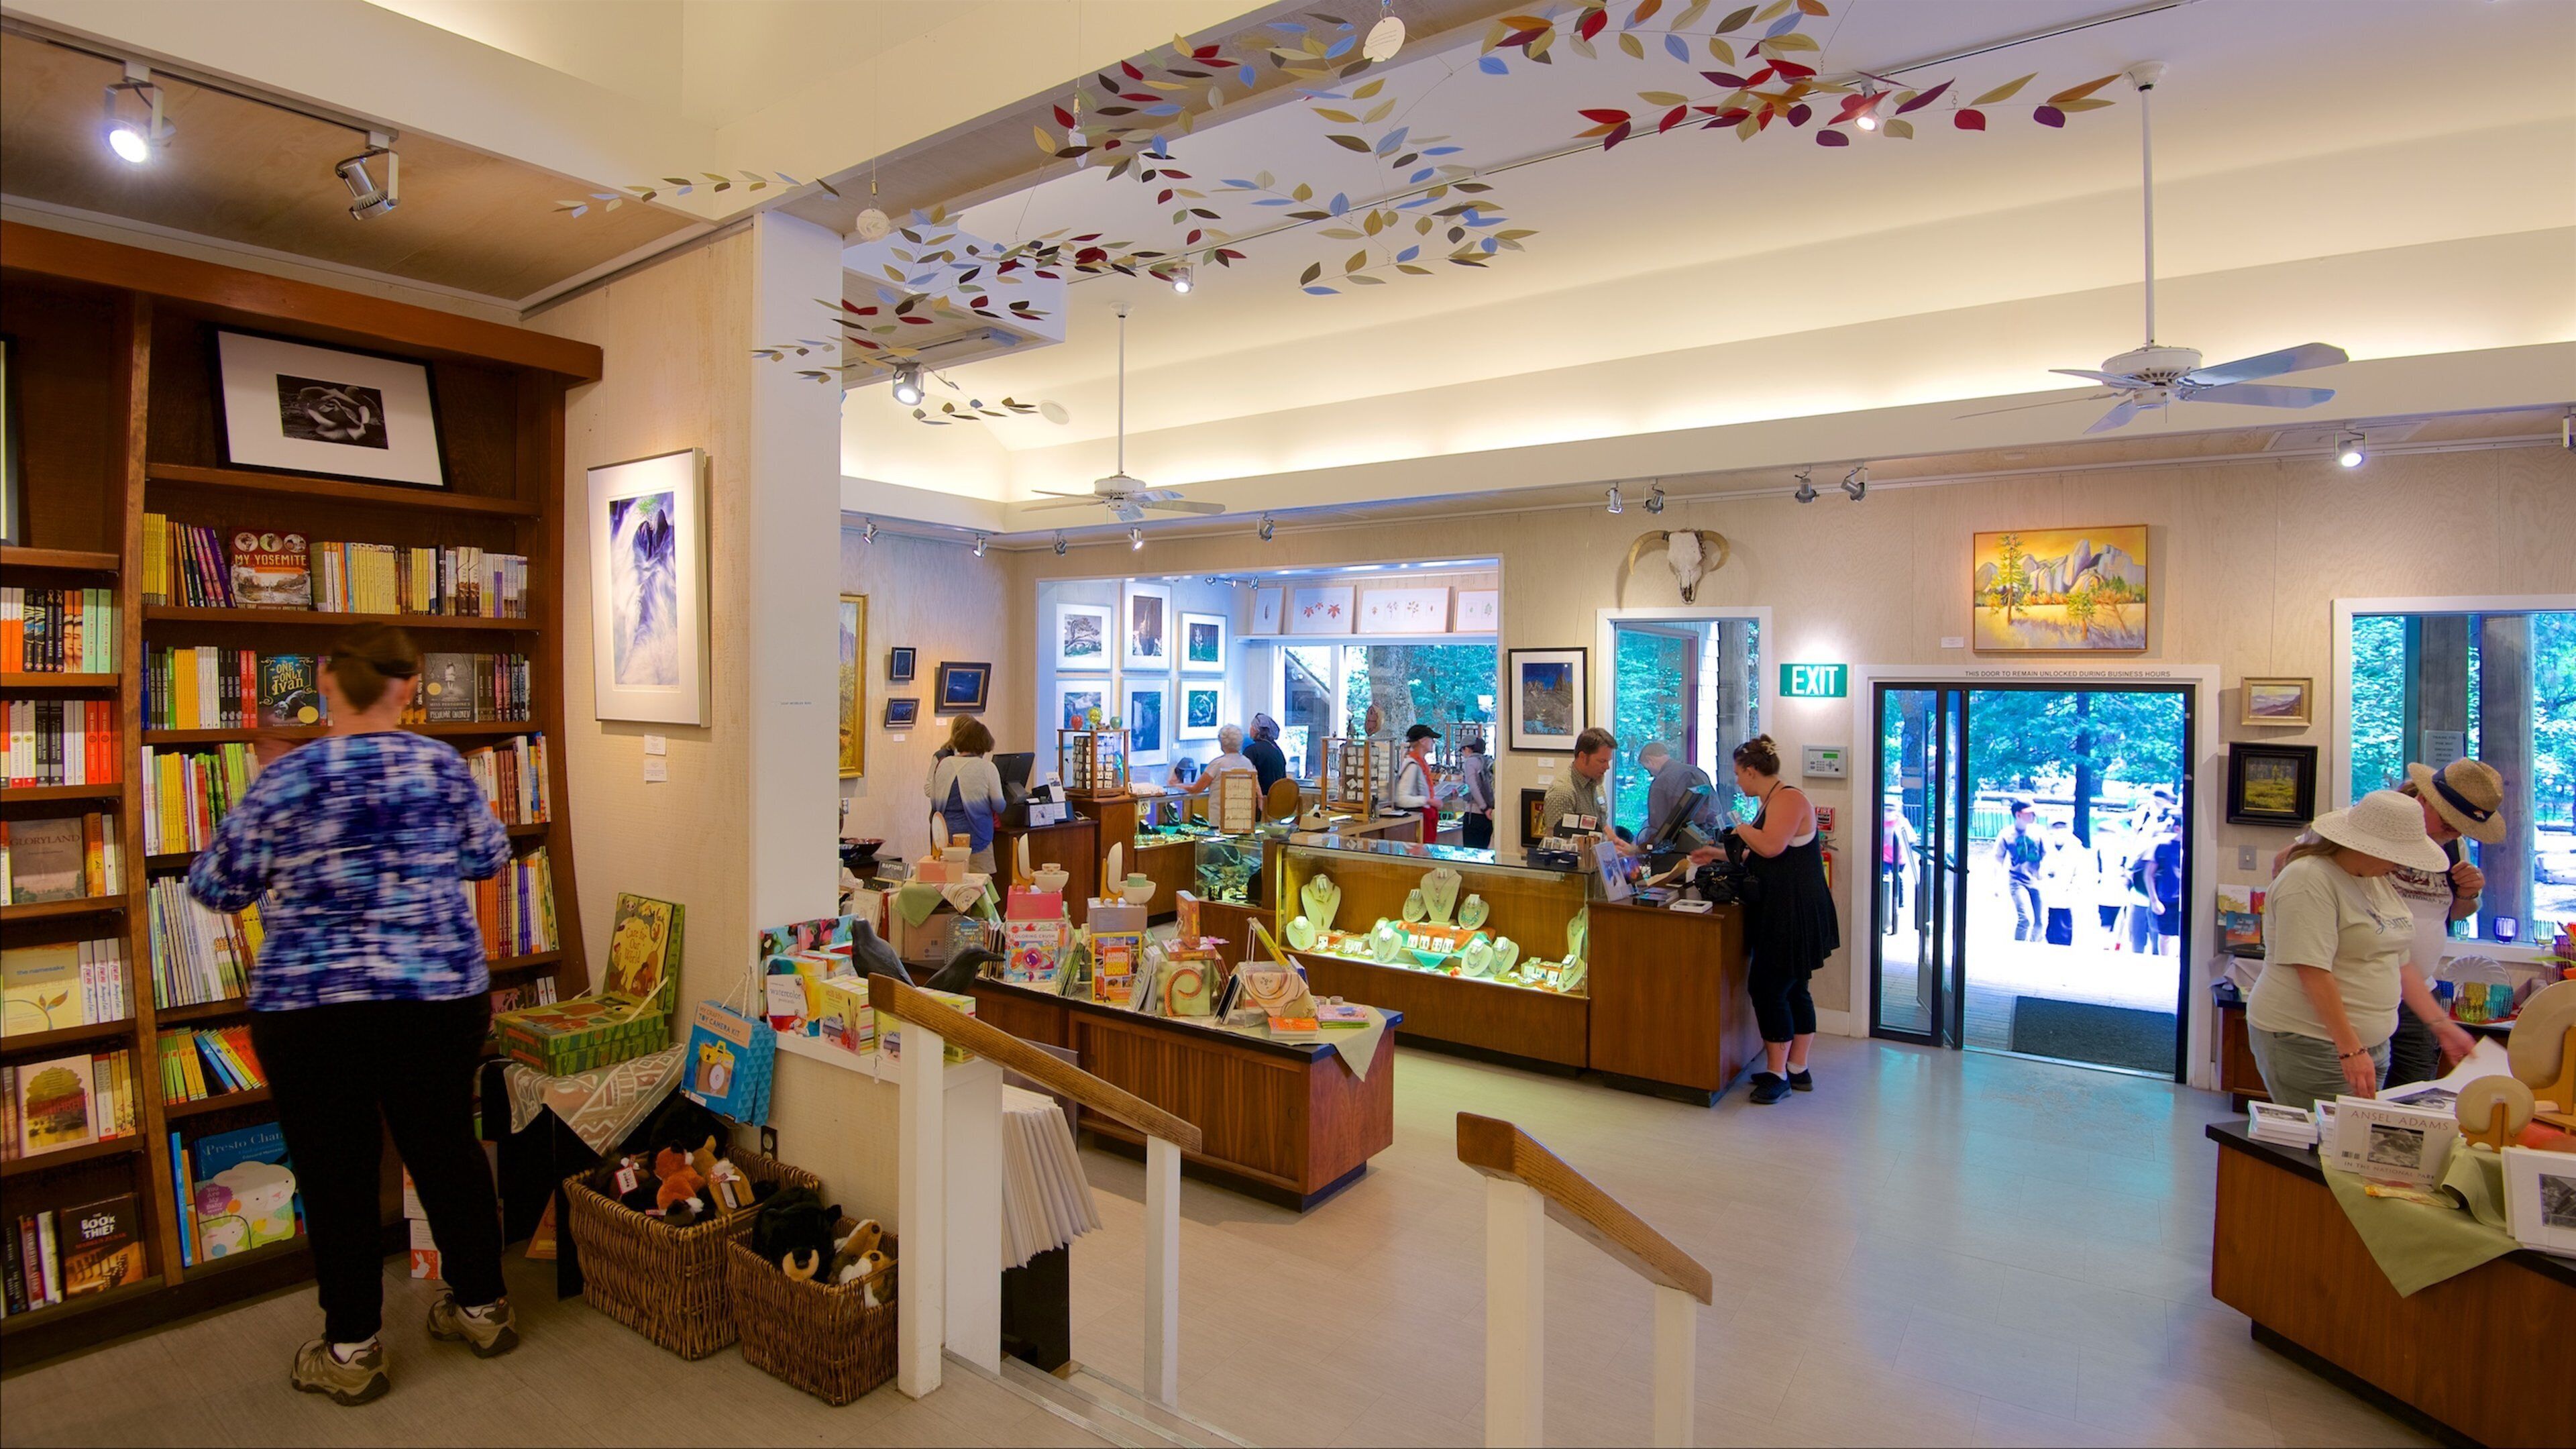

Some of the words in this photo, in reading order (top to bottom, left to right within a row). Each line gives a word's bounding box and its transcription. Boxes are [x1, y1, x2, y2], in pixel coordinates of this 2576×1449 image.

[235, 554, 250, 565] MY
[255, 554, 307, 566] YOSEMITE
[276, 662, 294, 674] ONE
[279, 669, 303, 682] ONLY
[1792, 665, 1839, 695] EXIT
[271, 678, 304, 696] Ivan
[10, 835, 80, 846] GLORYLAND
[881, 863, 904, 871] RAPTORS
[2402, 893, 2437, 903] NATIONAL
[626, 927, 638, 939] Care
[629, 939, 641, 950] Our
[625, 948, 641, 964] World
[29, 965, 64, 973] namesake
[1106, 967, 1128, 975] BOOK
[769, 987, 802, 1000] watercolor
[698, 1013, 709, 1024] TOY
[709, 1017, 731, 1033] CAMERA
[731, 1027, 741, 1037] KIT
[2351, 1110, 2392, 1123] ANSEL
[2398, 1116, 2449, 1131] ADAMS
[206, 1140, 248, 1156] Presto
[250, 1132, 283, 1144] Chan
[2373, 1167, 2413, 1177] NATIONAL
[81, 1215, 116, 1230] BOOK
[83, 1224, 115, 1239] THIEF
